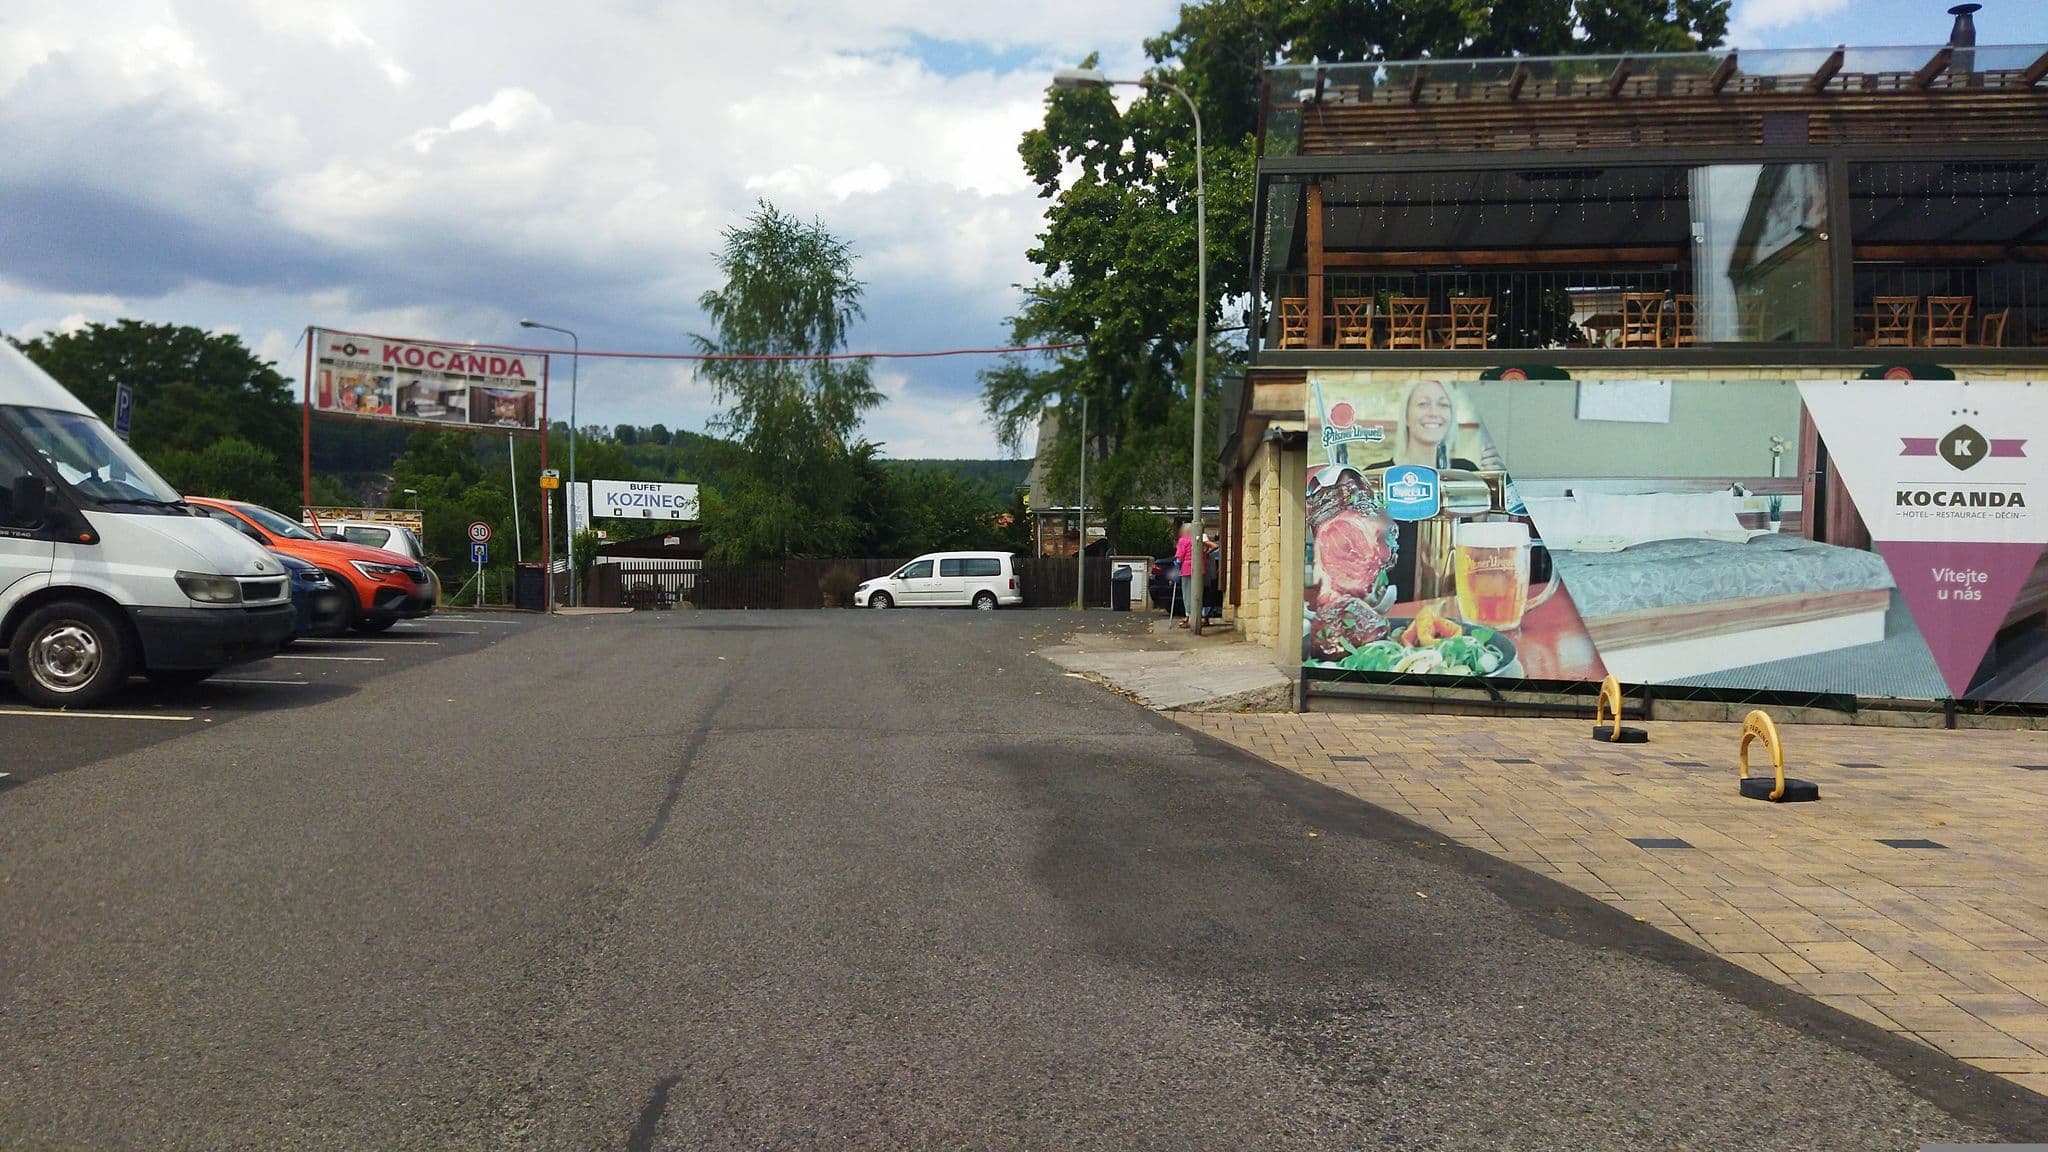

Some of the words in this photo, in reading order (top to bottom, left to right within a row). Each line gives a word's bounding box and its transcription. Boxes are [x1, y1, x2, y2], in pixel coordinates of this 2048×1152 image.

[383, 344, 525, 378] KOCANDA
[120, 391, 129, 417] P
[1954, 439, 1972, 456] K
[630, 483, 662, 492] BUFET
[607, 492, 685, 508] KOZINEC
[1896, 491, 2026, 507] KOCANDA
[1936, 511, 1986, 519] RESTAURACE
[473, 527, 486, 537] 30
[1932, 567, 1988, 587] Vítejte
[1938, 589, 1948, 600] u
[1953, 586, 1982, 601] nás
